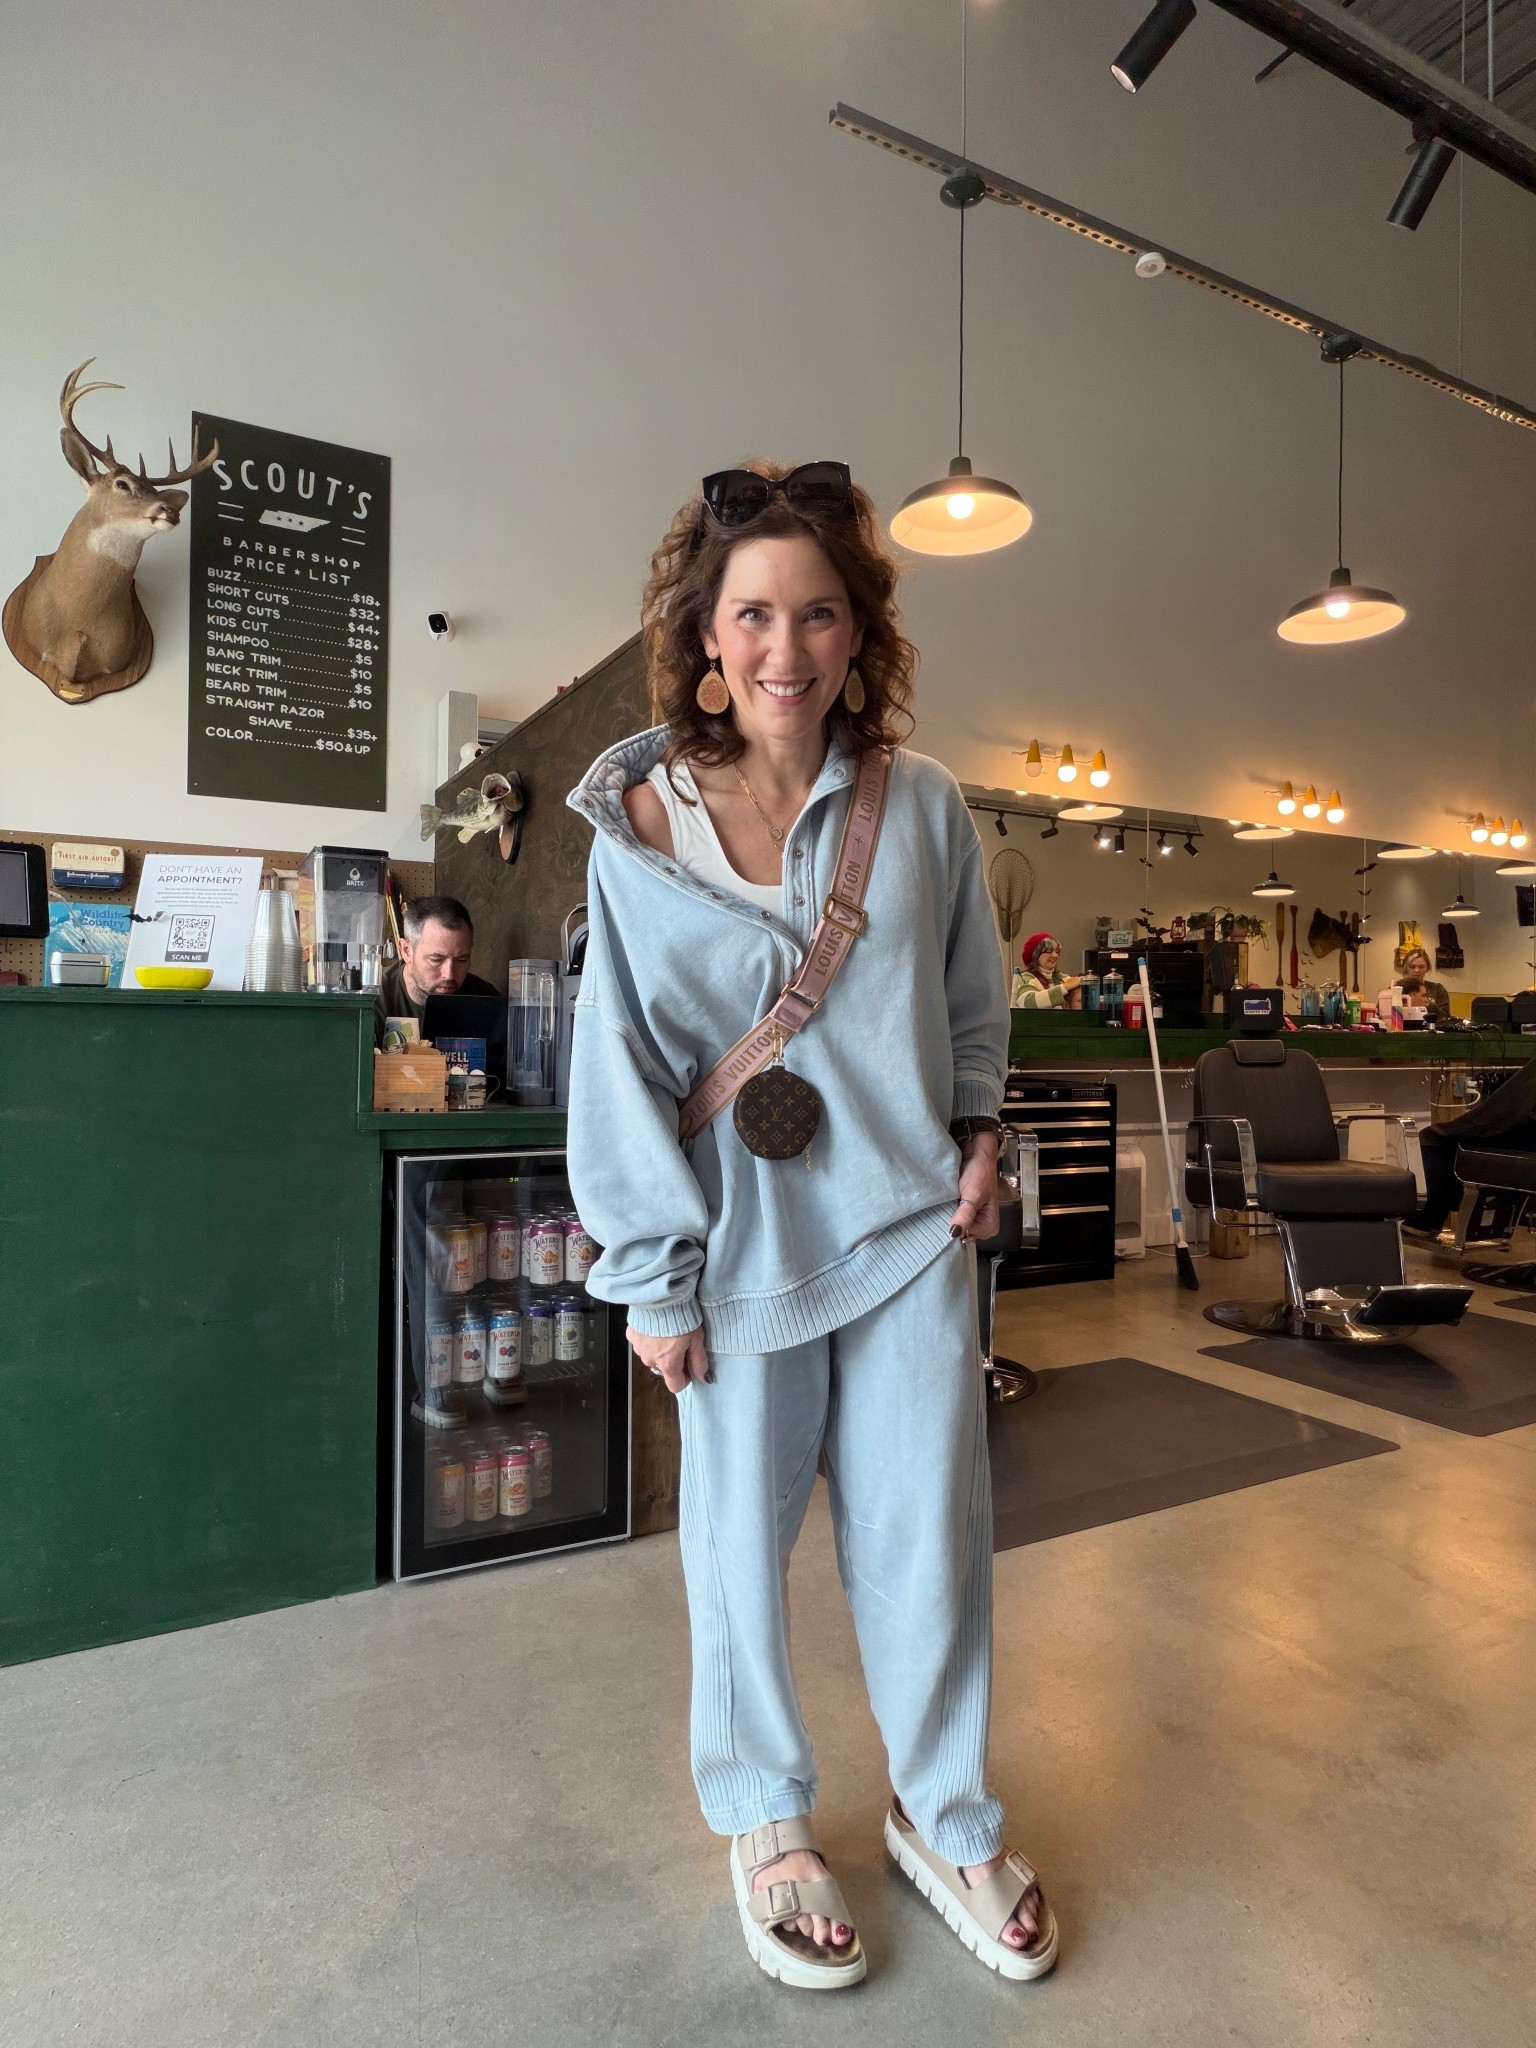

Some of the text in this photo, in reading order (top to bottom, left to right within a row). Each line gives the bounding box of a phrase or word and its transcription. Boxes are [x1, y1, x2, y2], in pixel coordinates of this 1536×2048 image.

[212, 459, 372, 519] SCOUT'S
[223, 536, 361, 570] BARBERSHOP
[207, 567, 380, 607] BUZZ $18+
[233, 555, 351, 586] PRICE LIST
[207, 583, 380, 621] SHORT CUTS $32+
[207, 599, 380, 636] LONG CUTS $44+
[206, 631, 373, 666] SHAMPOO $5
[207, 614, 380, 651] KIDS CUT $28+
[206, 646, 372, 680] BANG TRIM $10
[206, 662, 372, 695] NECK TRIM $5
[205, 678, 372, 710] BEARD TRIM $10
[205, 694, 325, 719] STRAIGHT RAZOR
[205, 726, 254, 741] COLOR
[248, 715, 377, 742] SHAVE $35+
[858, 777, 880, 823] LOUIS
[157, 875, 243, 885] APPOINTMENT?
[159, 865, 242, 875] DON'T HAVE AN
[346, 879, 365, 887] BRITA
[80, 908, 124, 919] Wildlife
[80, 918, 125, 930] Country
[191, 954, 203, 962] ME
[814, 927, 845, 977] LOUIS
[691, 1027, 776, 1119] LOUIS VUITTON
